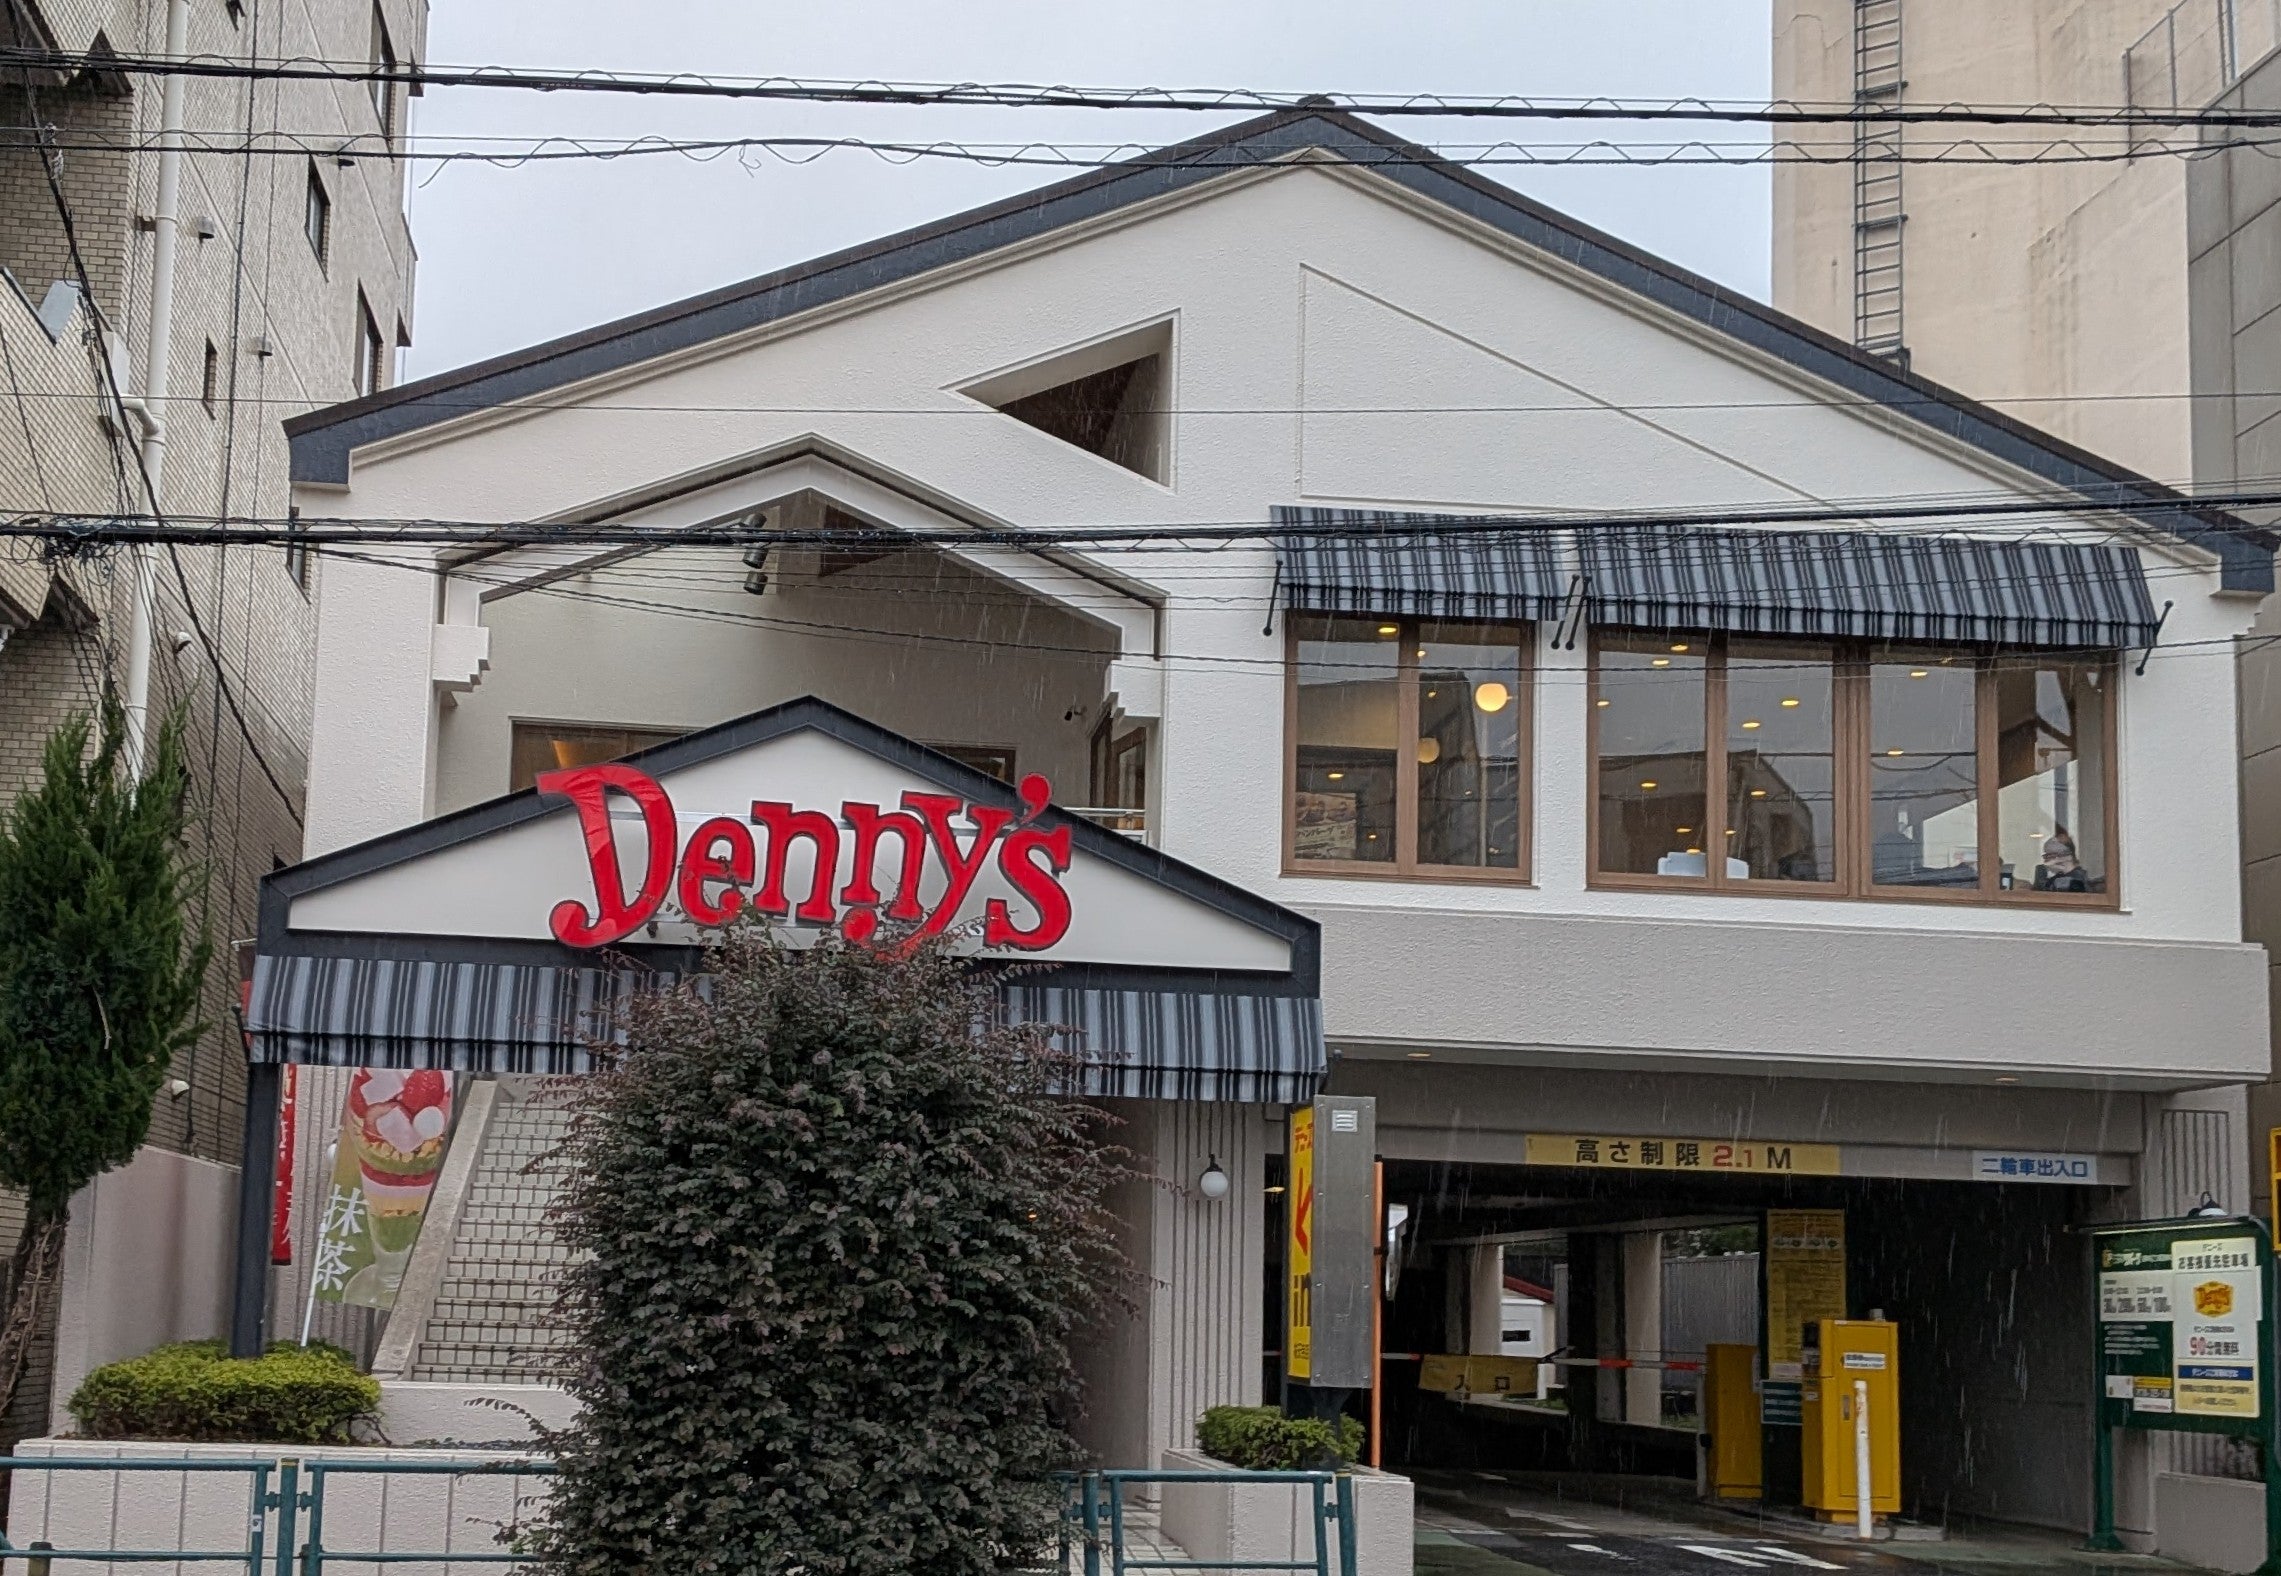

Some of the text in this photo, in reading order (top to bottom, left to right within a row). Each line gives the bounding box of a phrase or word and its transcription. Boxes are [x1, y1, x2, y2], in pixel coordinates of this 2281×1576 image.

[536, 762, 1073, 962] Denny's
[1575, 1138, 1792, 1169] 高さ制限 2.1 M
[1981, 1157, 2088, 1177] 二輪車出入口
[316, 1183, 369, 1291] 抹茶
